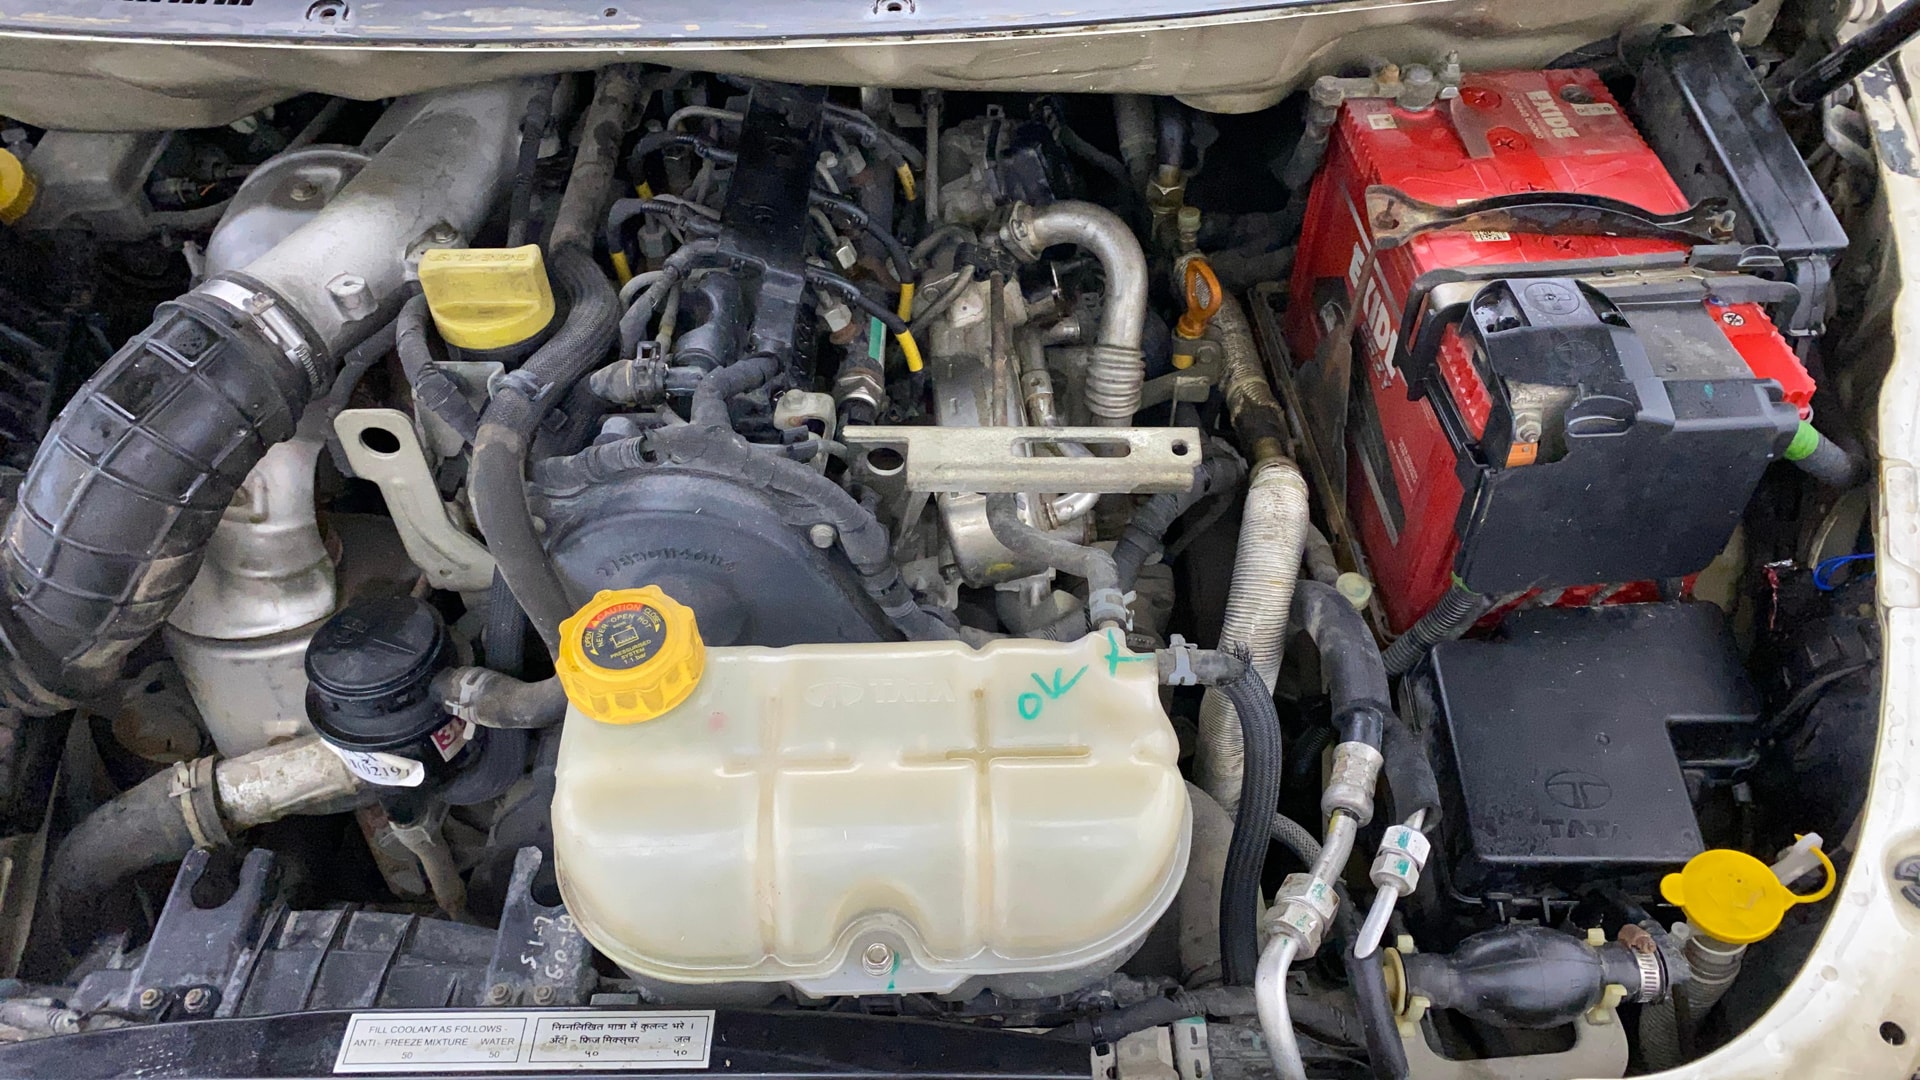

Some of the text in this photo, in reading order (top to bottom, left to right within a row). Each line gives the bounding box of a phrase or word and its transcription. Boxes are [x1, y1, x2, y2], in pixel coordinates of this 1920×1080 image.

[1525, 90, 1580, 138] EXIDE
[596, 603, 642, 621] CAUTION
[644, 607, 661, 625] CLOSE
[595, 623, 609, 648] NEVER
[610, 613, 635, 623] OPEN
[637, 615, 652, 629] HOT
[610, 639, 652, 659] PRESSURISED
[620, 648, 646, 660] SYSTEM
[1017, 664, 1090, 720] OK
[368, 1026, 388, 1034] FILL
[390, 1025, 438, 1034] COOLANT
[439, 1025, 452, 1033] AS
[454, 1025, 502, 1033] FOLLOWS
[551, 1021, 604, 1031] निम्नलिखित
[608, 1022, 626, 1030] मात्रा
[630, 1020, 638, 1030] में
[640, 1022, 668, 1033] कुलन्ट
[671, 1020, 685, 1030] भरे
[353, 1038, 376, 1047] ANTI
[384, 1038, 422, 1047] FREEZE
[424, 1037, 469, 1046] MIXTURE
[480, 1037, 515, 1046] WATER
[673, 1035, 691, 1044] जल
[401, 1050, 500, 1060] 50 50
[584, 1049, 600, 1058] ५०
[673, 1049, 688, 1058] ५०
